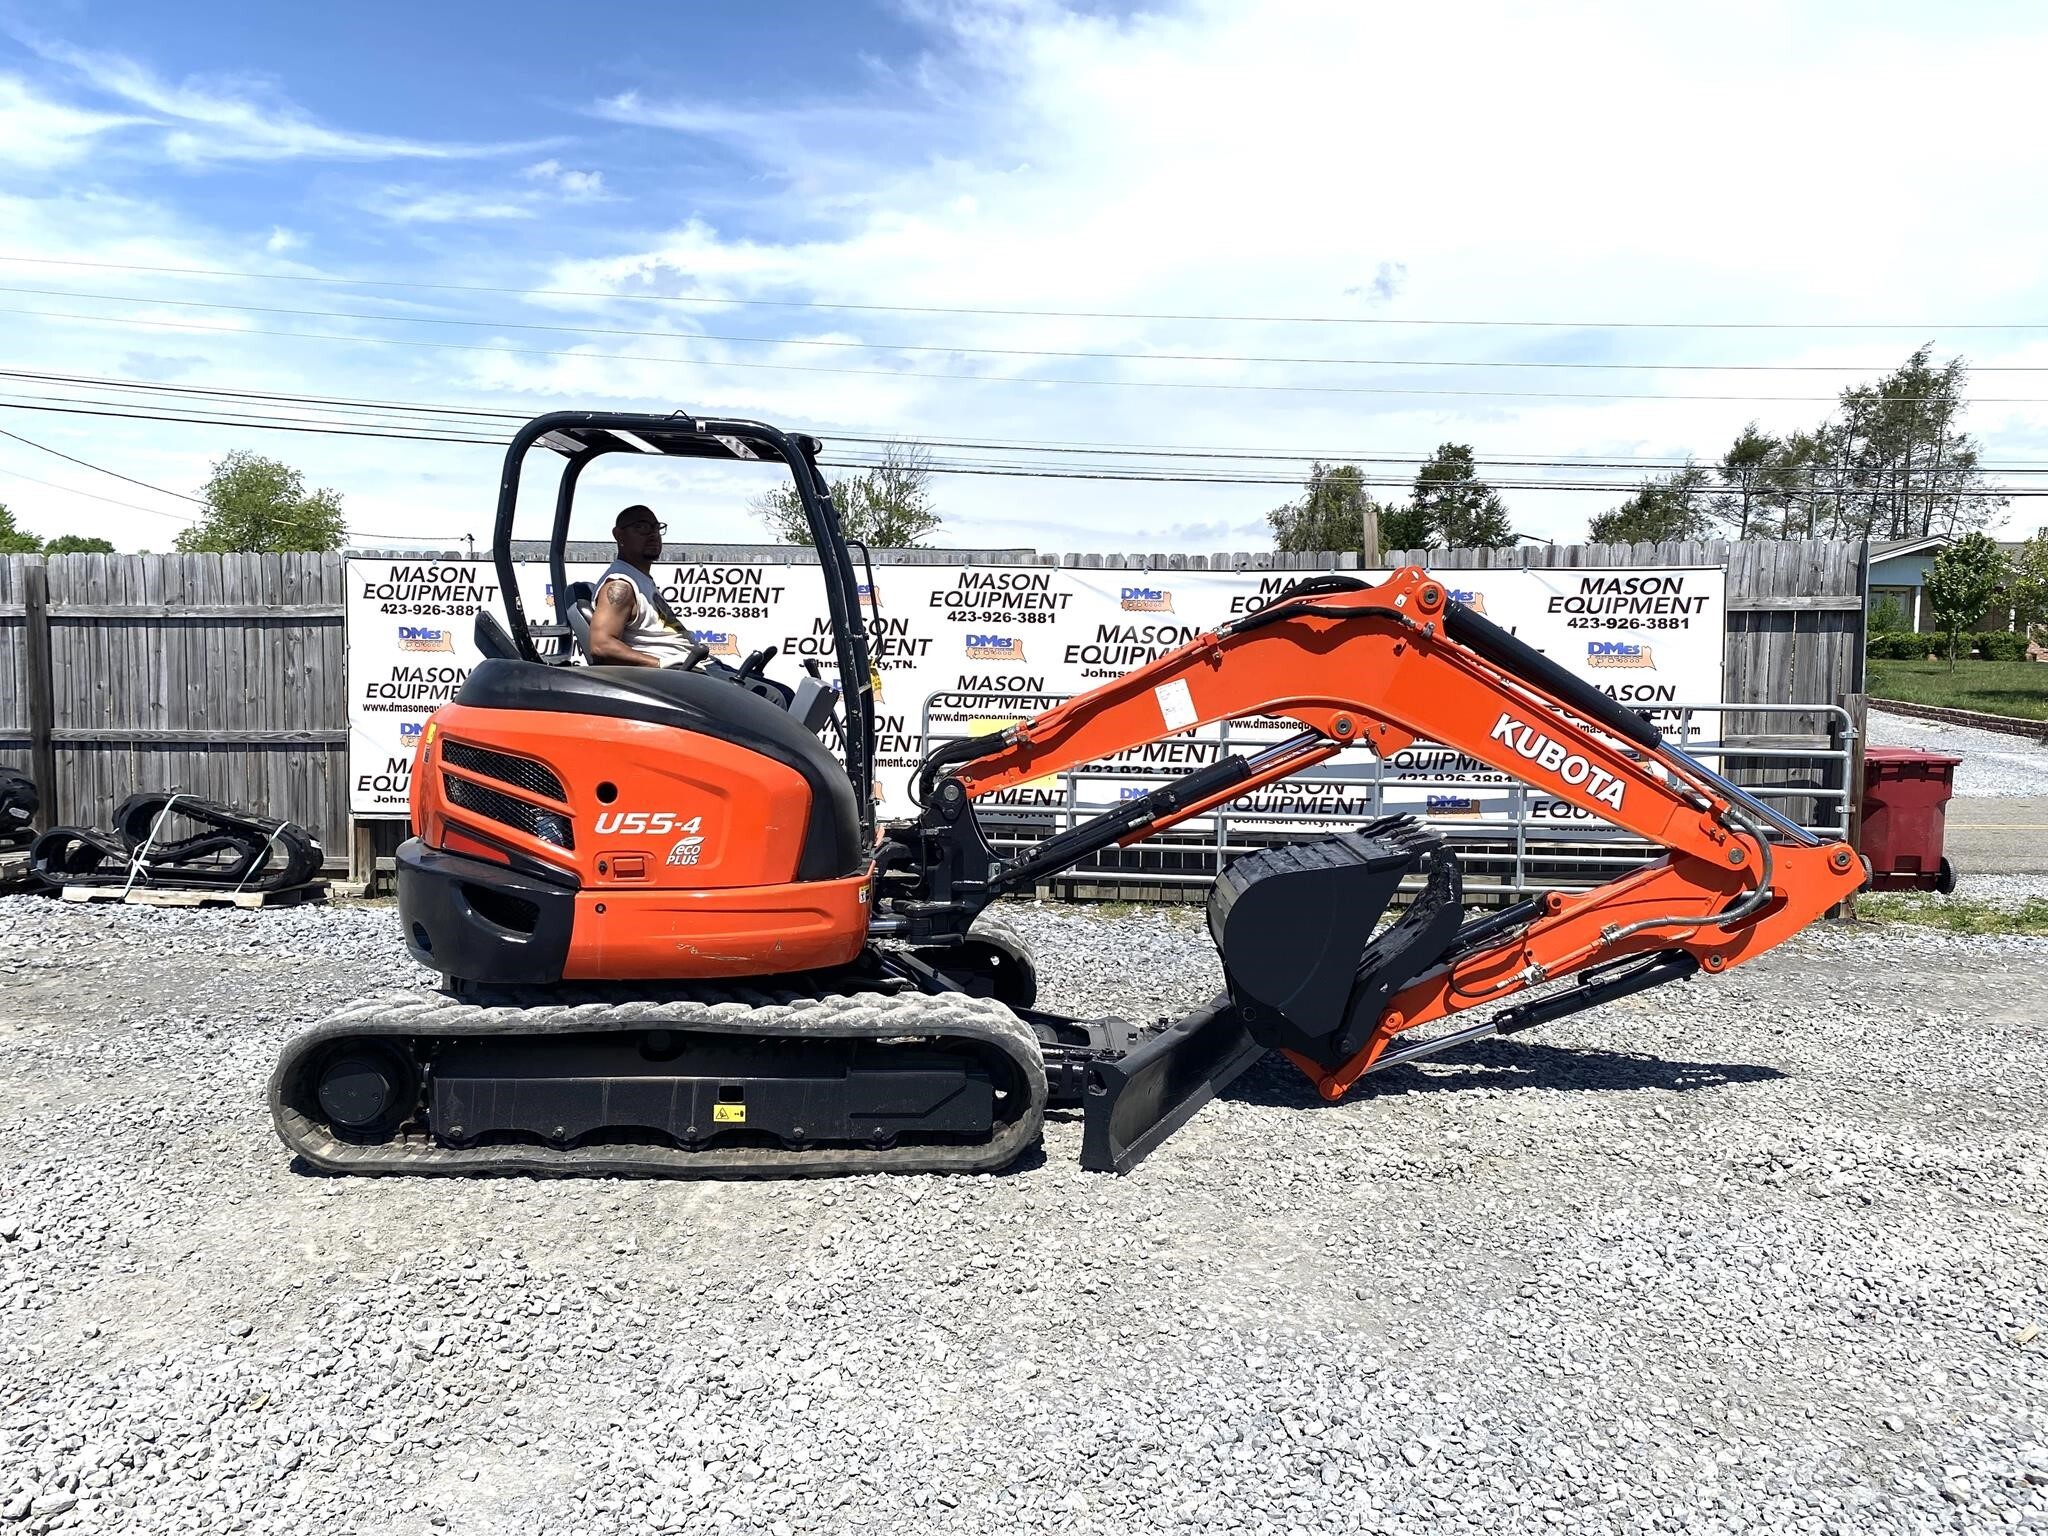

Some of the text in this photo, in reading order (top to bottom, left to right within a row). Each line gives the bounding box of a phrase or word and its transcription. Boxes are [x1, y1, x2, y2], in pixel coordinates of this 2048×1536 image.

[389, 566, 476, 584] MASON
[674, 568, 762, 585] MASON
[958, 572, 1050, 591] MASON
[363, 583, 499, 602] EQUIPMENT
[1580, 577, 1684, 595] MASON
[658, 588, 785, 604] QUIPMENT
[929, 590, 1073, 609] EQUIPMENT
[1547, 596, 1709, 614] EQUIPMENT
[671, 607, 769, 618] 23-926-3881
[947, 611, 1055, 623] 423-926-3881
[813, 618, 909, 636] MON
[1567, 617, 1690, 629] 423-926-3881
[1096, 624, 1200, 645] MASON
[782, 637, 933, 656] EQUMENT
[1063, 645, 1172, 665] EQUIPM
[1081, 668, 1132, 678] John
[957, 675, 1044, 692] MASON
[1596, 685, 1676, 702] ASON
[929, 697, 1061, 710] EQUIPMEN
[1490, 711, 1627, 812] KUBOTA
[1229, 796, 1371, 815] QUIPMENT
[594, 812, 702, 834] U55-4
[676, 845, 701, 855] eco
[666, 855, 699, 866] PLUS
